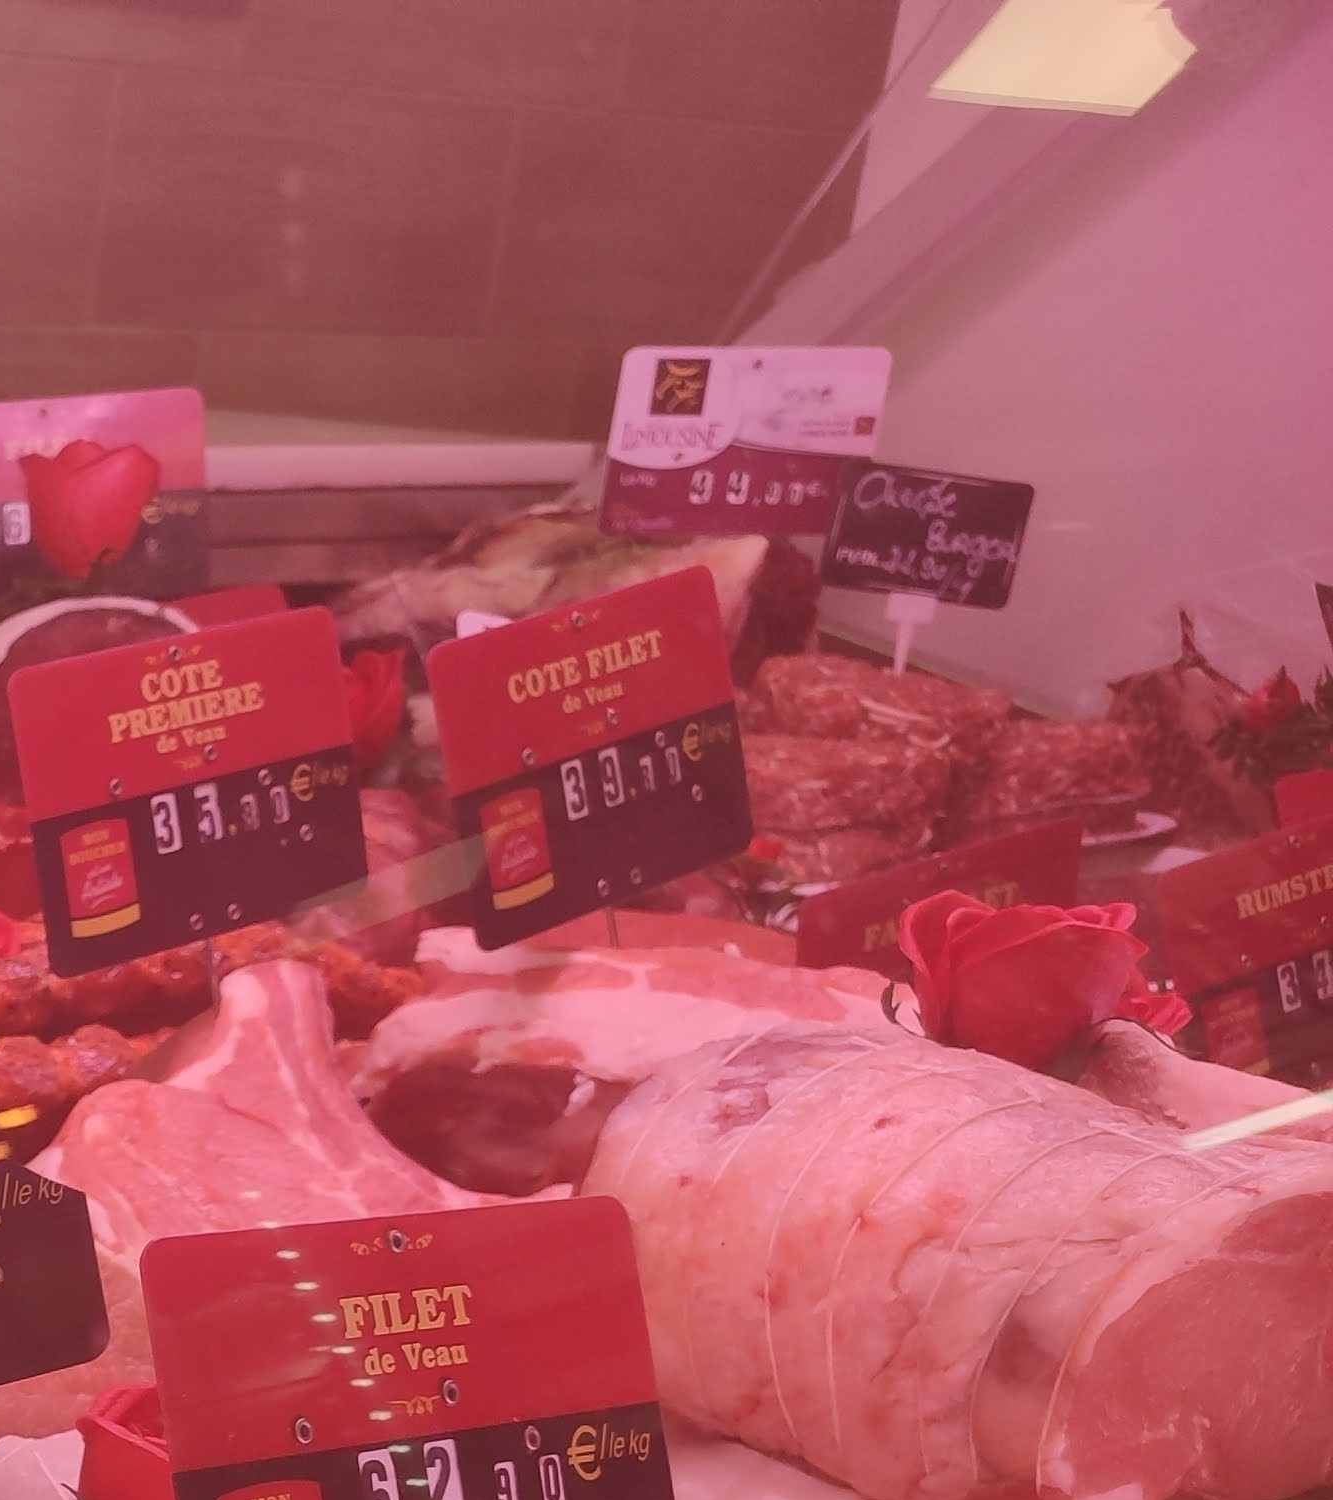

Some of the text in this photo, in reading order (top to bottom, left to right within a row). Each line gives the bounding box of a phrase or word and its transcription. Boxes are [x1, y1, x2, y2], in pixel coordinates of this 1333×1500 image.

[140, 659, 224, 703] COTE
[507, 630, 663, 704] COTE FILET
[108, 682, 266, 744] PREMIERE
[562, 694, 582, 714] de
[339, 1284, 472, 1339] FILET
[364, 1342, 469, 1376] de Veau
[627, 1428, 652, 1462] kg
